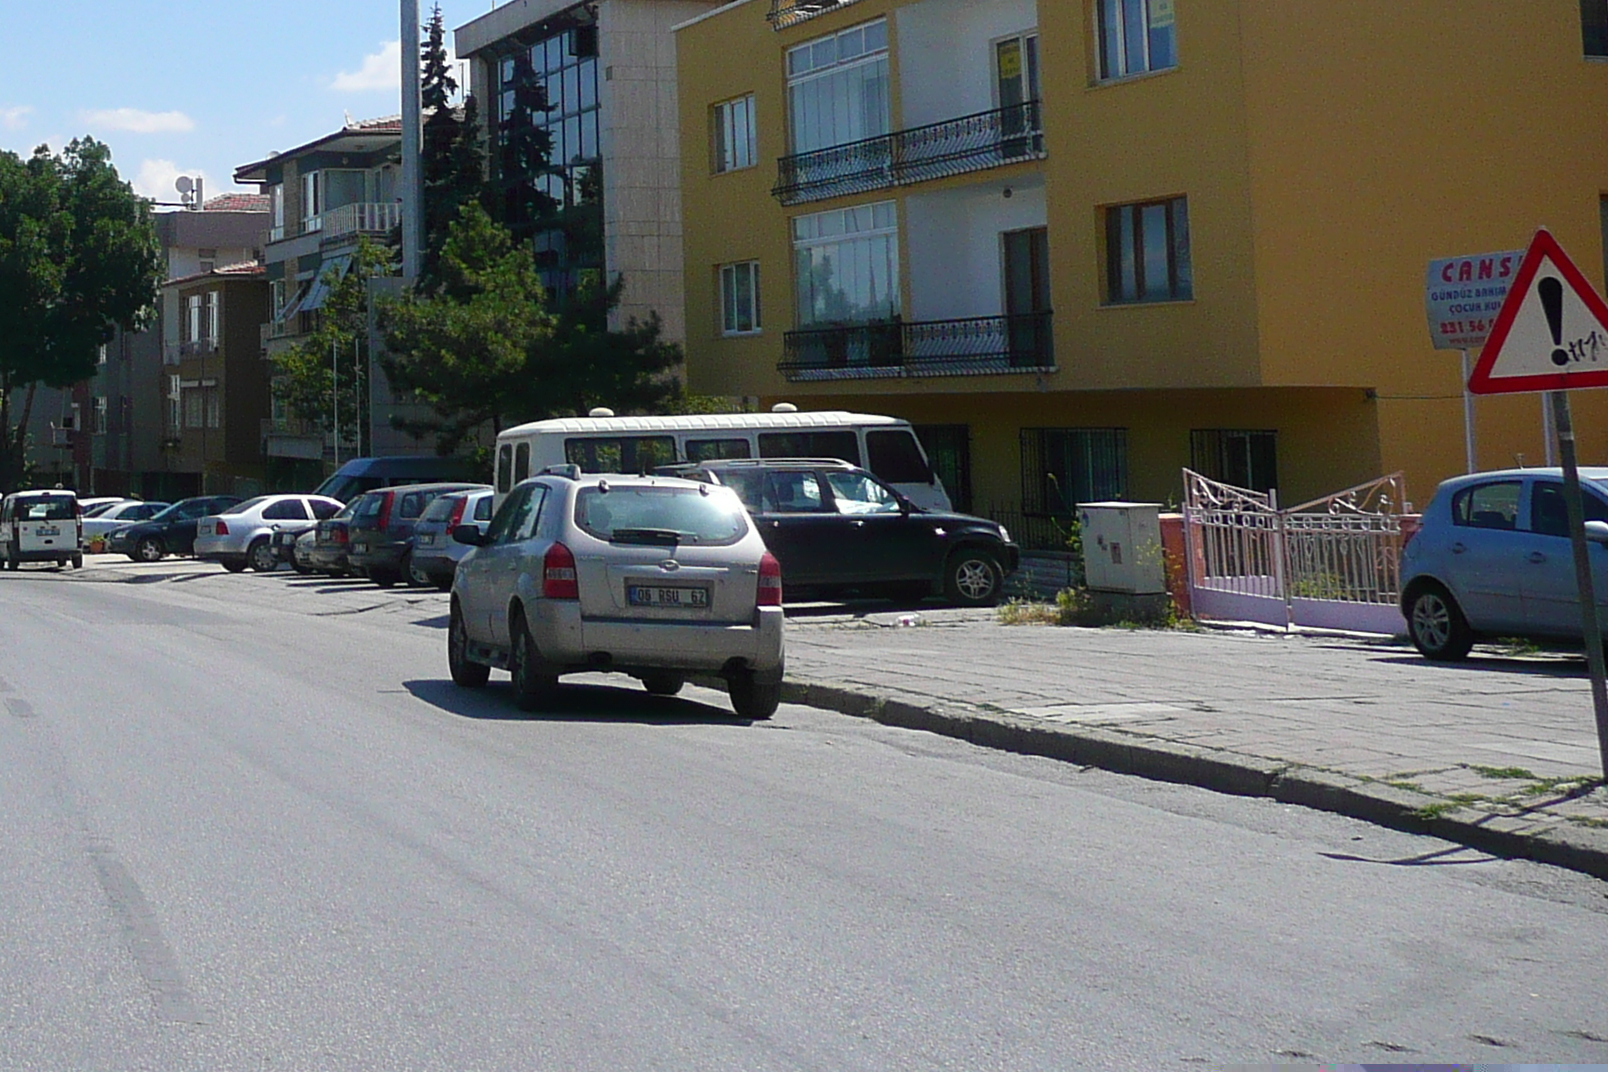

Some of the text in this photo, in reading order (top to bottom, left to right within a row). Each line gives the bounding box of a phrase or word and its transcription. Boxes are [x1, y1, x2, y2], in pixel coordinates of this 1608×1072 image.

[1431, 288, 1473, 301] GÜNDÜZ
[1449, 303, 1482, 316] ÇOCUK
[1469, 319, 1486, 333] 56
[658, 589, 680, 604] RSU
